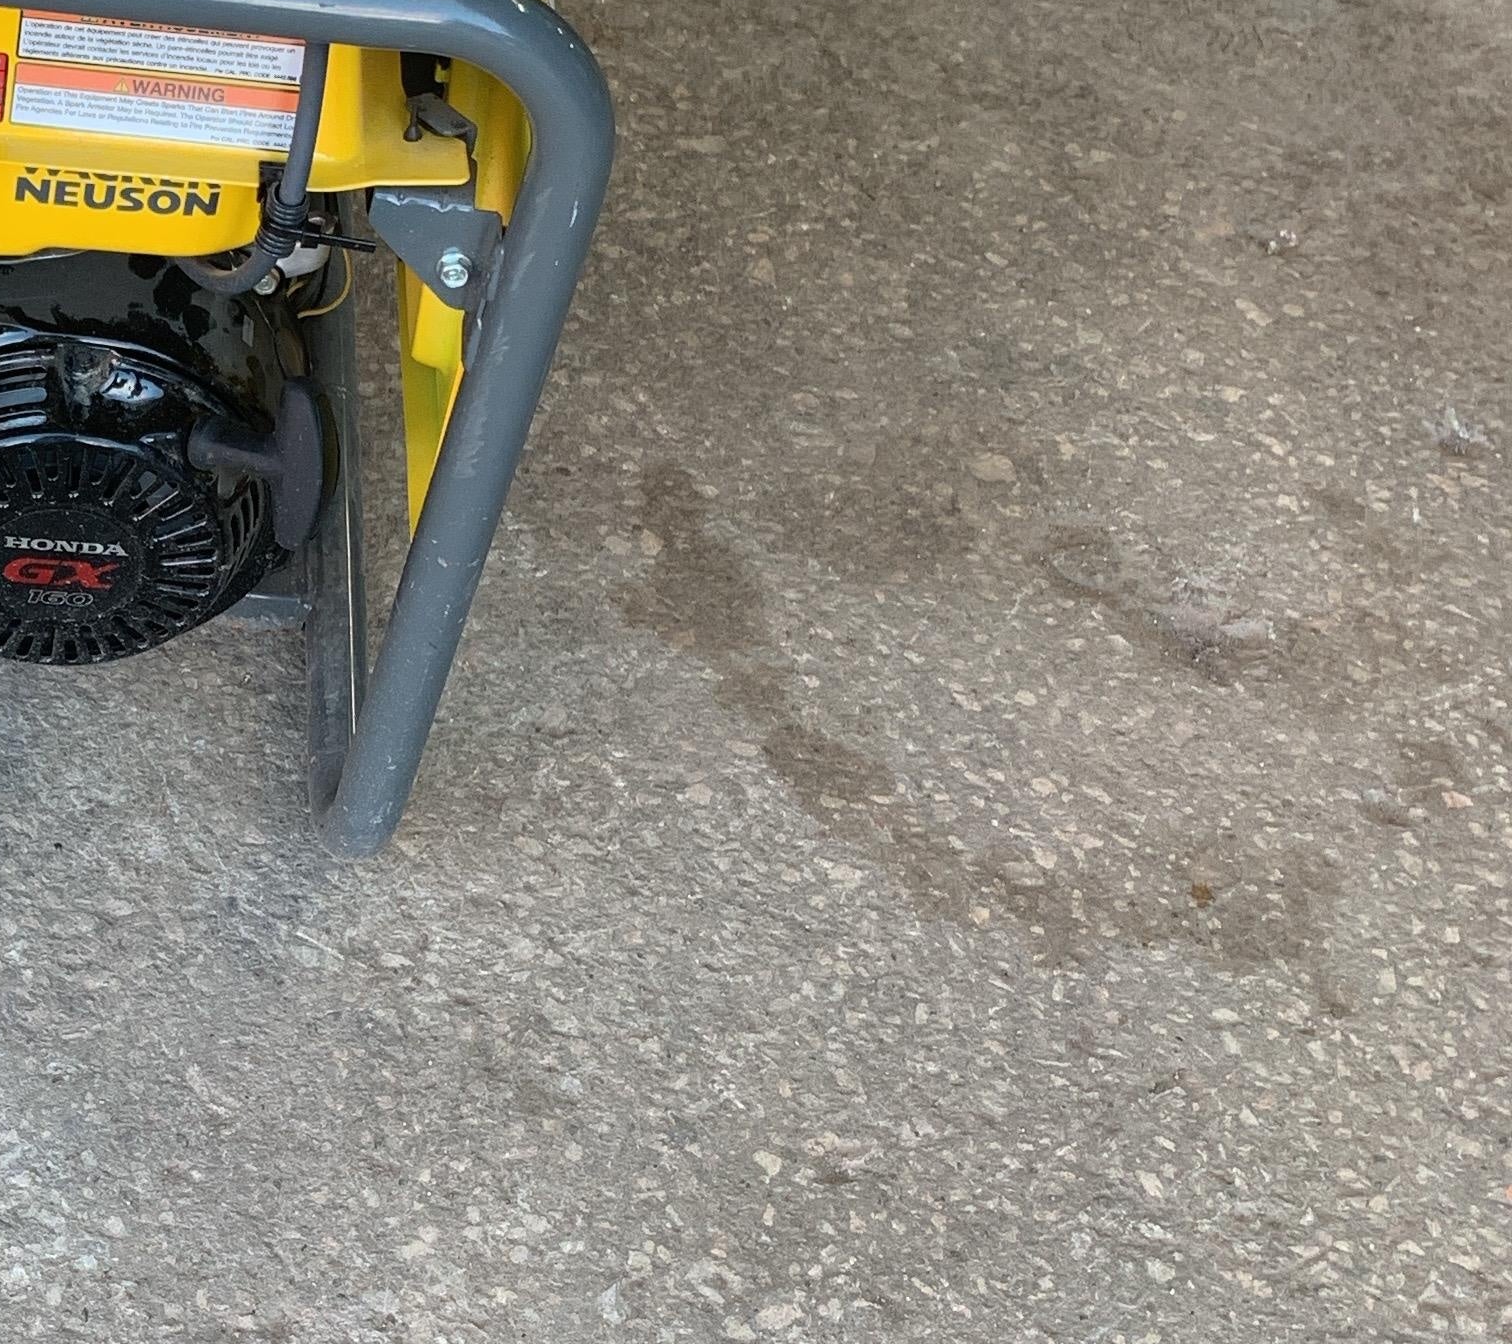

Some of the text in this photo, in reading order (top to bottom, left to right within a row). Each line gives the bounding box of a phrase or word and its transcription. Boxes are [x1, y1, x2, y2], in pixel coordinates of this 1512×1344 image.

[132, 79, 225, 102] WARNING
[15, 177, 221, 216] NEUSON
[4, 536, 129, 557] HONDA
[2, 557, 120, 590] GX
[27, 588, 94, 606] 160
